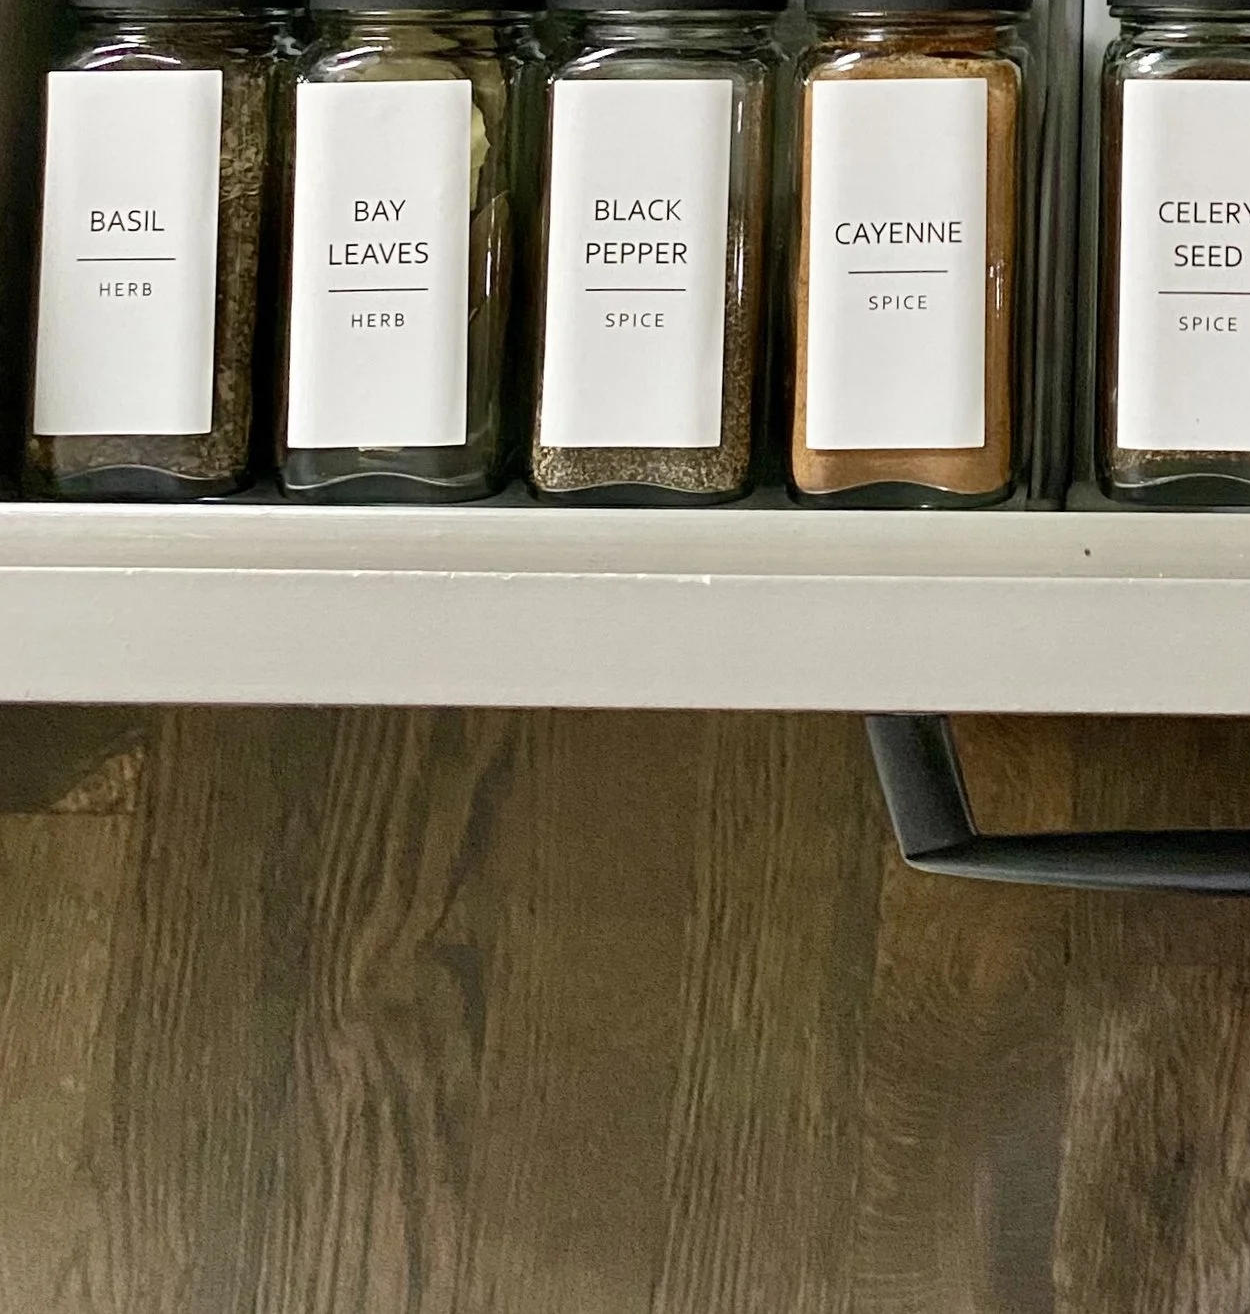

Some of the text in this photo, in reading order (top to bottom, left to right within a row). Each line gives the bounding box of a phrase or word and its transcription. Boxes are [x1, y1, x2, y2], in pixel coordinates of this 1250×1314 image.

[89, 209, 166, 233] BASIL
[353, 198, 407, 223] BAY
[594, 198, 683, 222] BLACK
[834, 220, 963, 246] CAYENNE
[328, 241, 429, 266] LEAVES
[585, 241, 688, 265] PEPPER
[1173, 244, 1243, 268] SEED
[98, 282, 153, 298] HERB
[868, 294, 928, 311] SPICE
[351, 312, 405, 329] HERB
[604, 312, 665, 328] SPICE
[1178, 315, 1238, 333] SPICE
